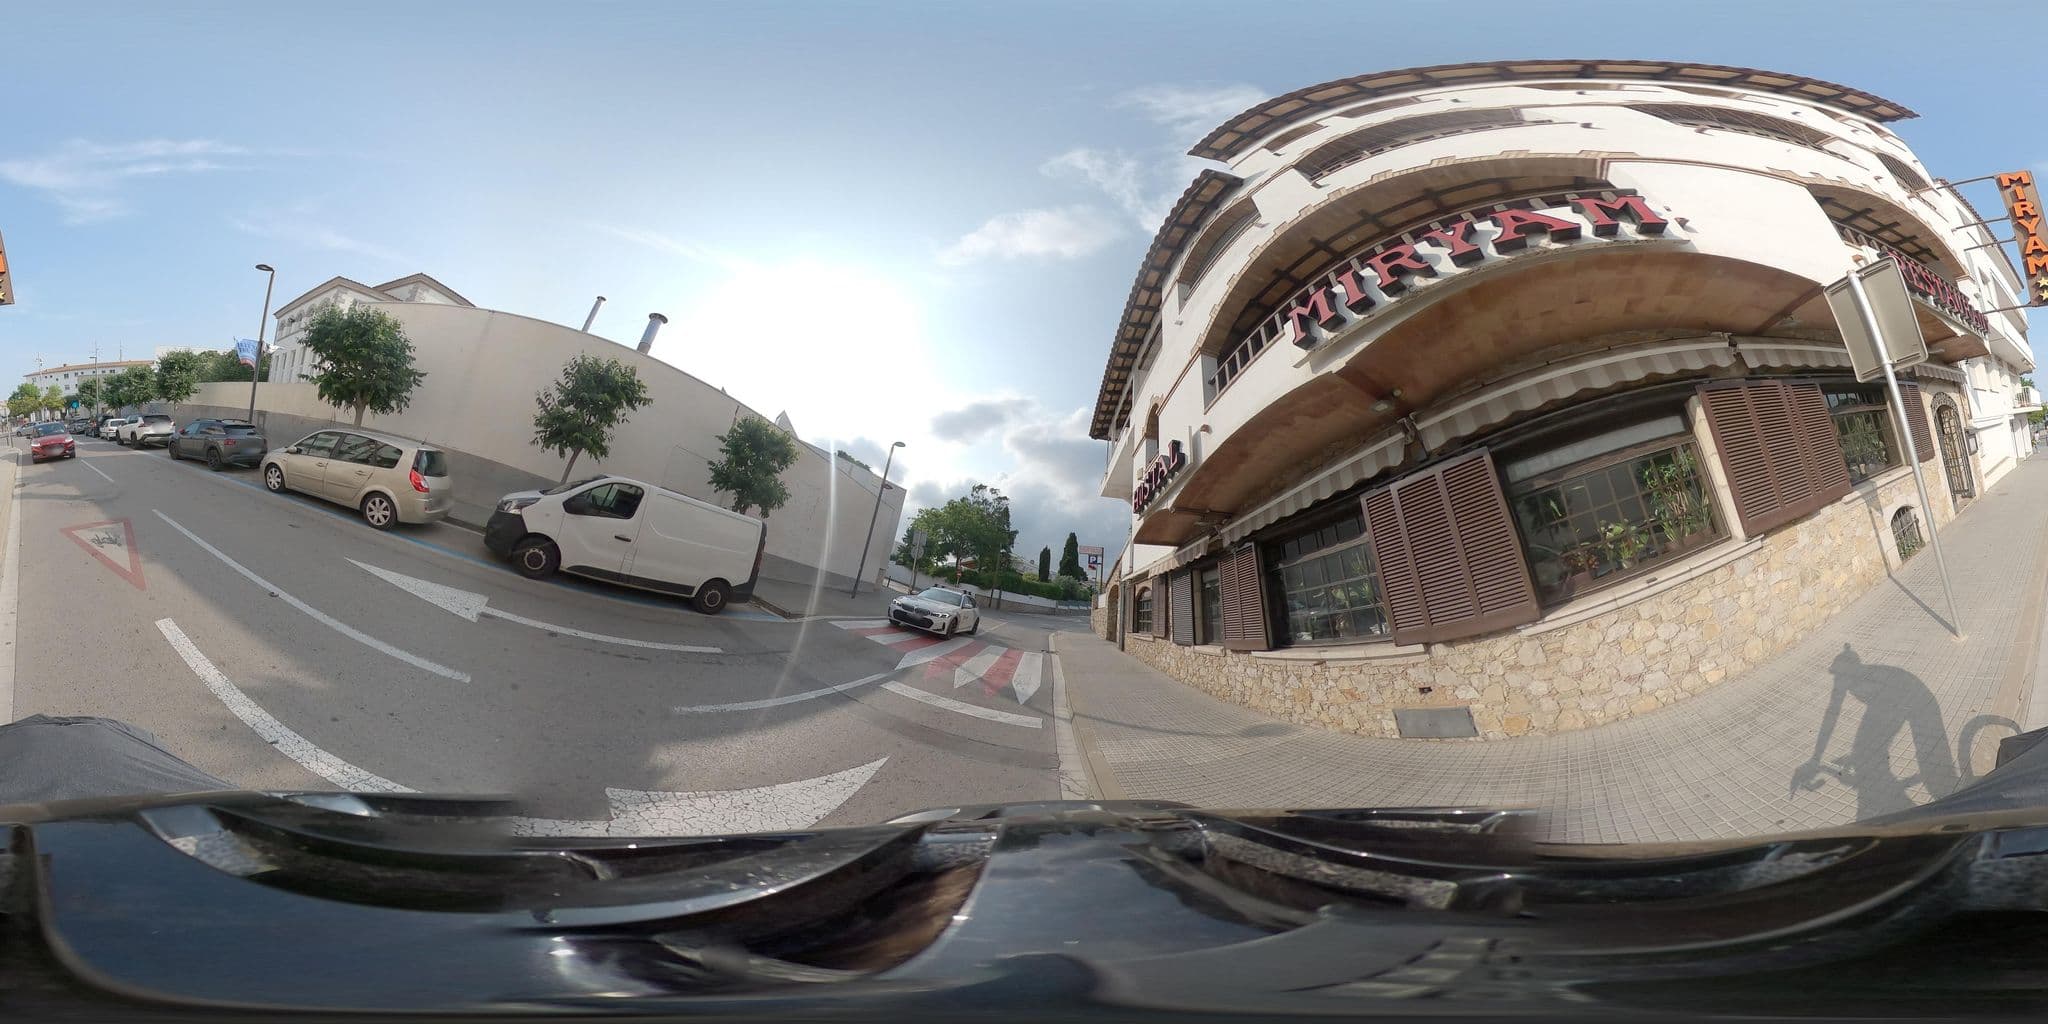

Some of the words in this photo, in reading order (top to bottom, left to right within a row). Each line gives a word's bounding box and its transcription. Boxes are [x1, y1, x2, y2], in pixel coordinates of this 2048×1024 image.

[1287, 195, 1669, 350] MIRYAM
[2000, 171, 2048, 275] MIRYAM
[1133, 441, 1182, 514] HOSTAL
